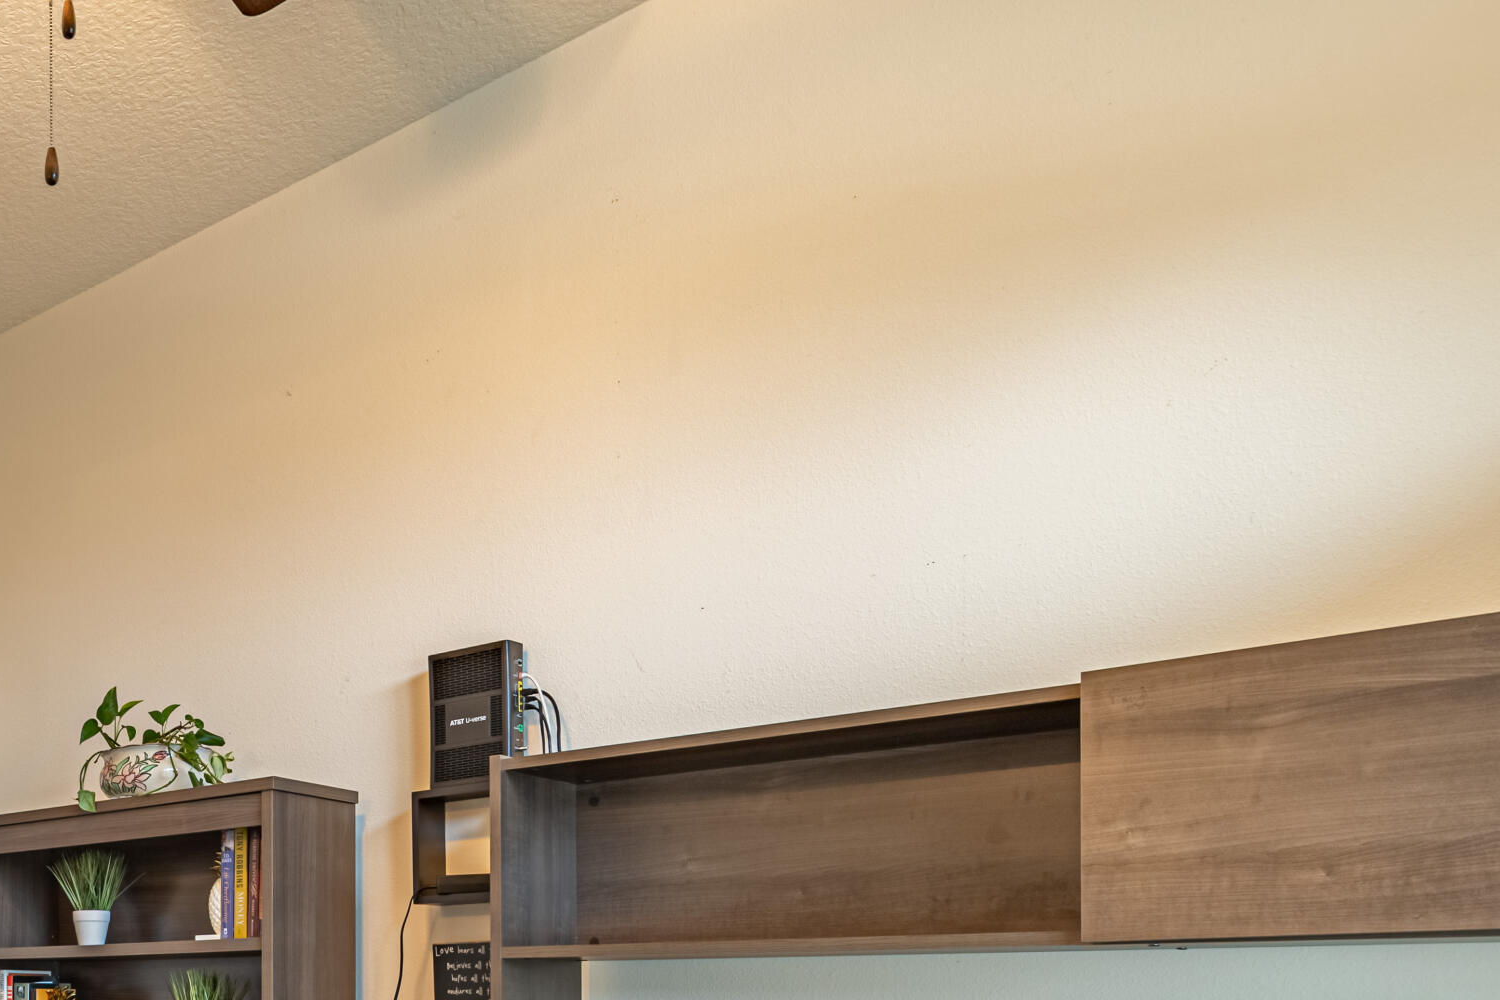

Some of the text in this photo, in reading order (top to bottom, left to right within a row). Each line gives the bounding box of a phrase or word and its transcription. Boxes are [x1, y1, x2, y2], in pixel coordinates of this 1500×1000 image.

[450, 718, 464, 727] AT&T
[236, 831, 245, 926] TONY ROBBINS MONEY
[434, 945, 454, 957] Love
[457, 946, 474, 954] bears
